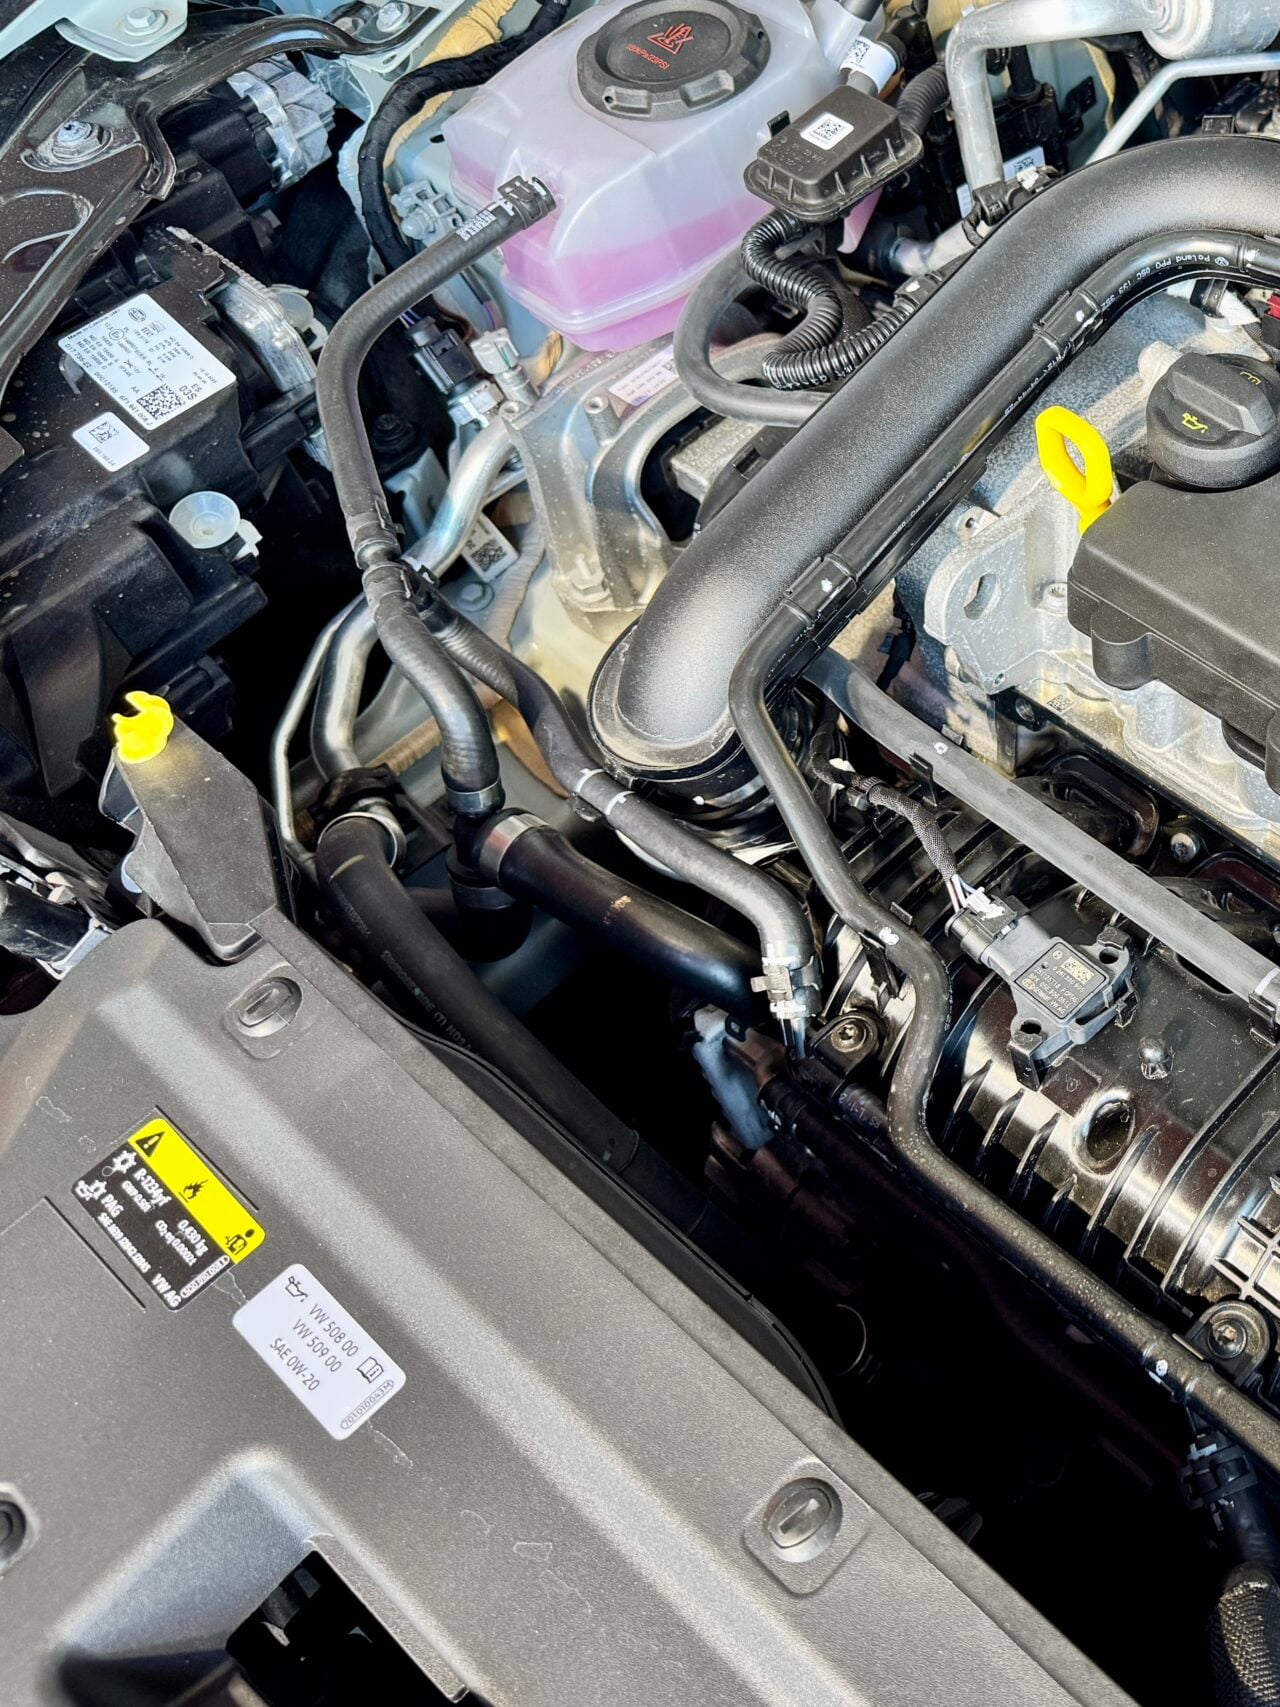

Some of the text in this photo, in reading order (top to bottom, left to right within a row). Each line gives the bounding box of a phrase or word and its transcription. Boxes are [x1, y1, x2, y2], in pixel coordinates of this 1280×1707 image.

[1153, 257, 1171, 268] PPO
[1175, 252, 1211, 265] Poland
[101, 1194, 123, 1217] PAG
[134, 1168, 171, 1206] R-1234yf
[178, 1220, 201, 1243] 0.430
[195, 1239, 208, 1256] kg
[152, 1274, 181, 1307] VW AG
[293, 1318, 342, 1372] VW 509 00
[309, 1304, 358, 1357] VW 508 00
[270, 1338, 320, 1391] SAE 0W-20
